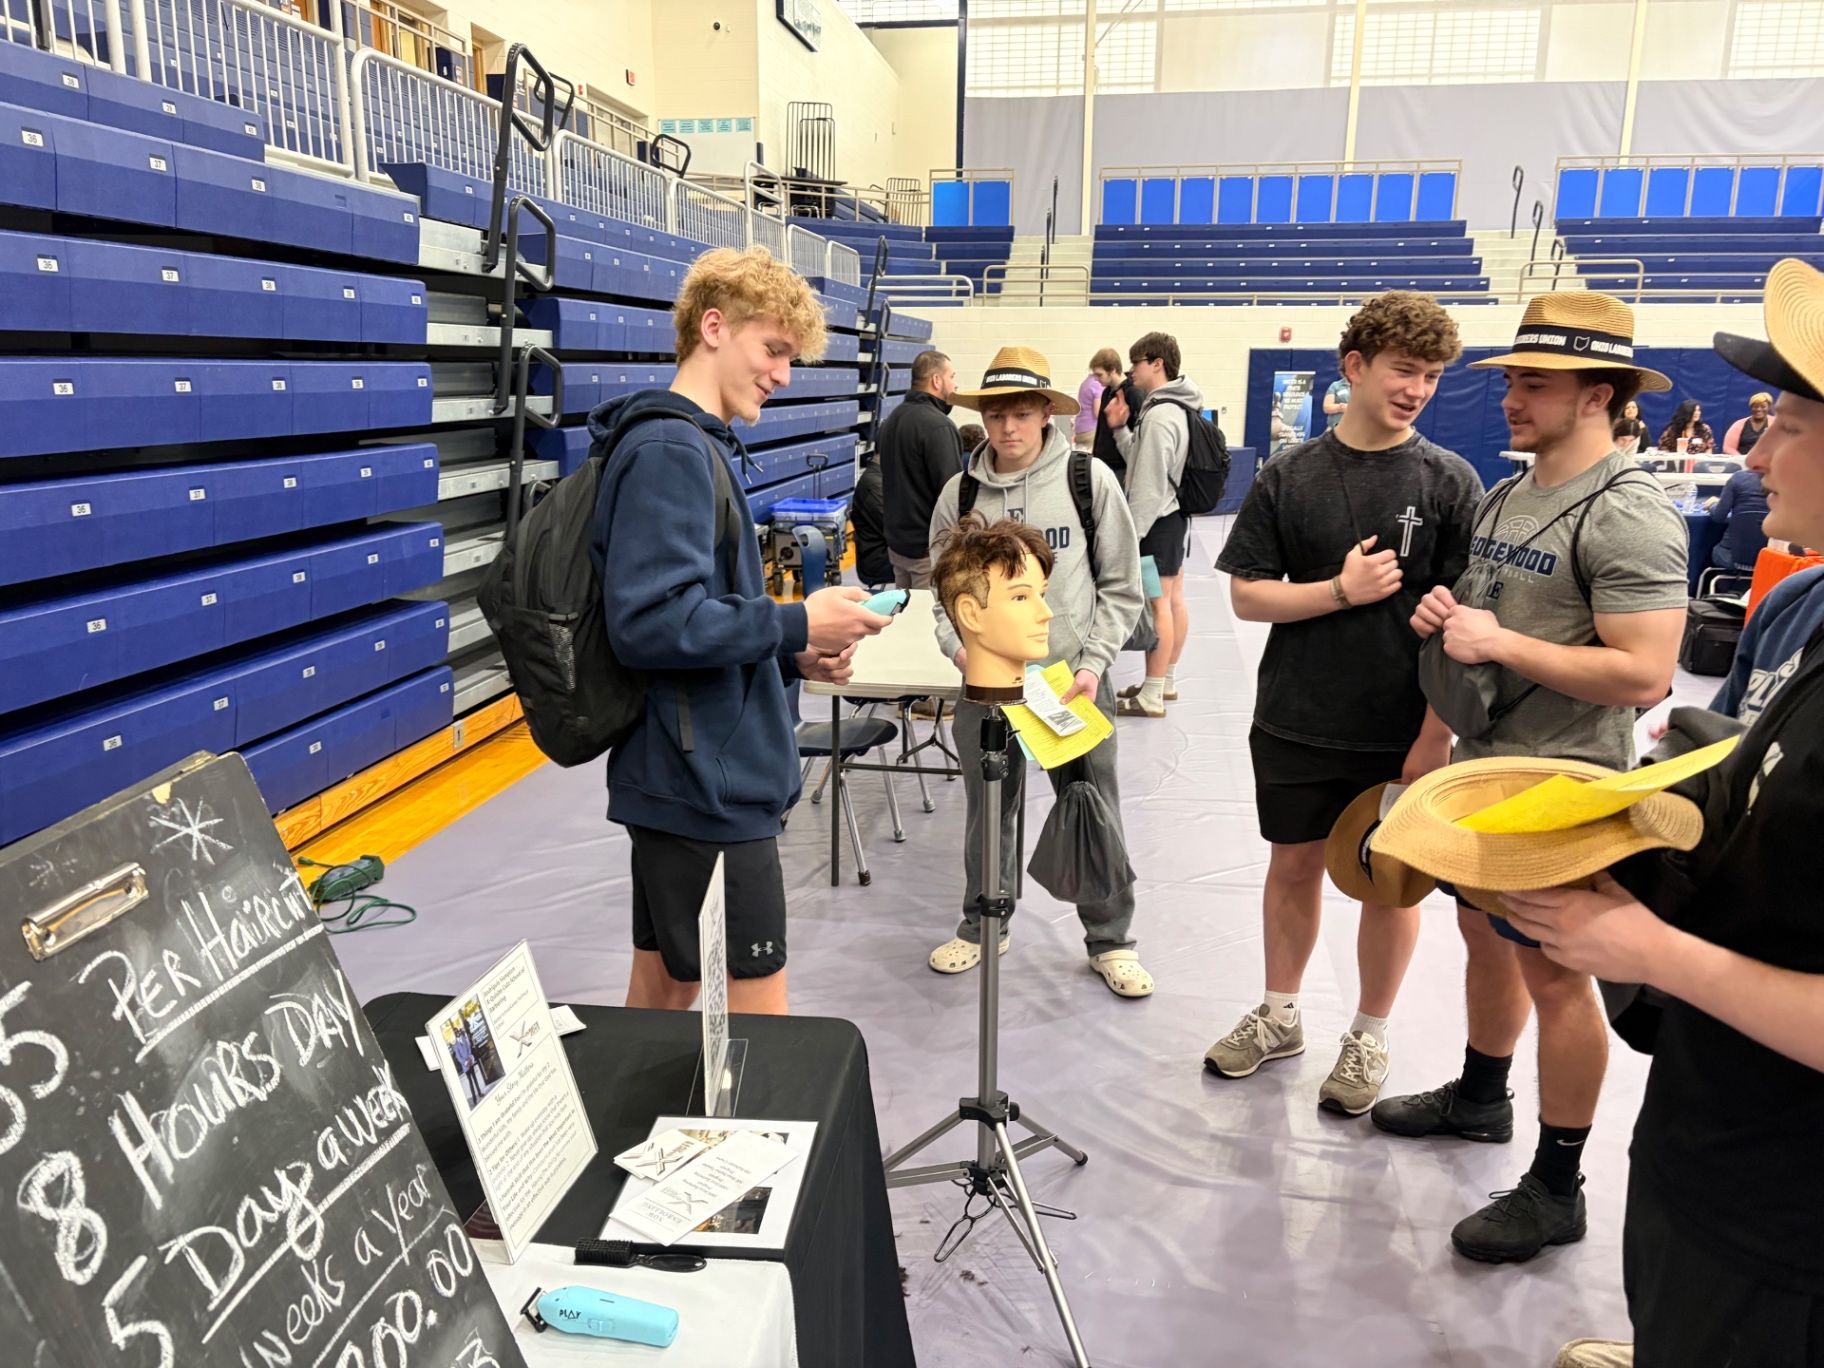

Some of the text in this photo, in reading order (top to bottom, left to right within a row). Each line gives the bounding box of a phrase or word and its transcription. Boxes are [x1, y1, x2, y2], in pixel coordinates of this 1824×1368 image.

[27, 133, 37, 143] 36
[153, 159, 161, 168] 37
[165, 271, 173, 279] 37
[58, 383, 68, 392] 36
[178, 382, 186, 390] 37
[193, 490, 200, 498] 37
[76, 505, 86, 514] 36
[205, 595, 212, 603] 37
[91, 621, 101, 631] 36
[107, 738, 118, 748] 36
[17, 1151, 107, 1286] 8
[102, 1255, 174, 1368] 5
[317, 1126, 349, 1171] a
[354, 1226, 383, 1266] a
